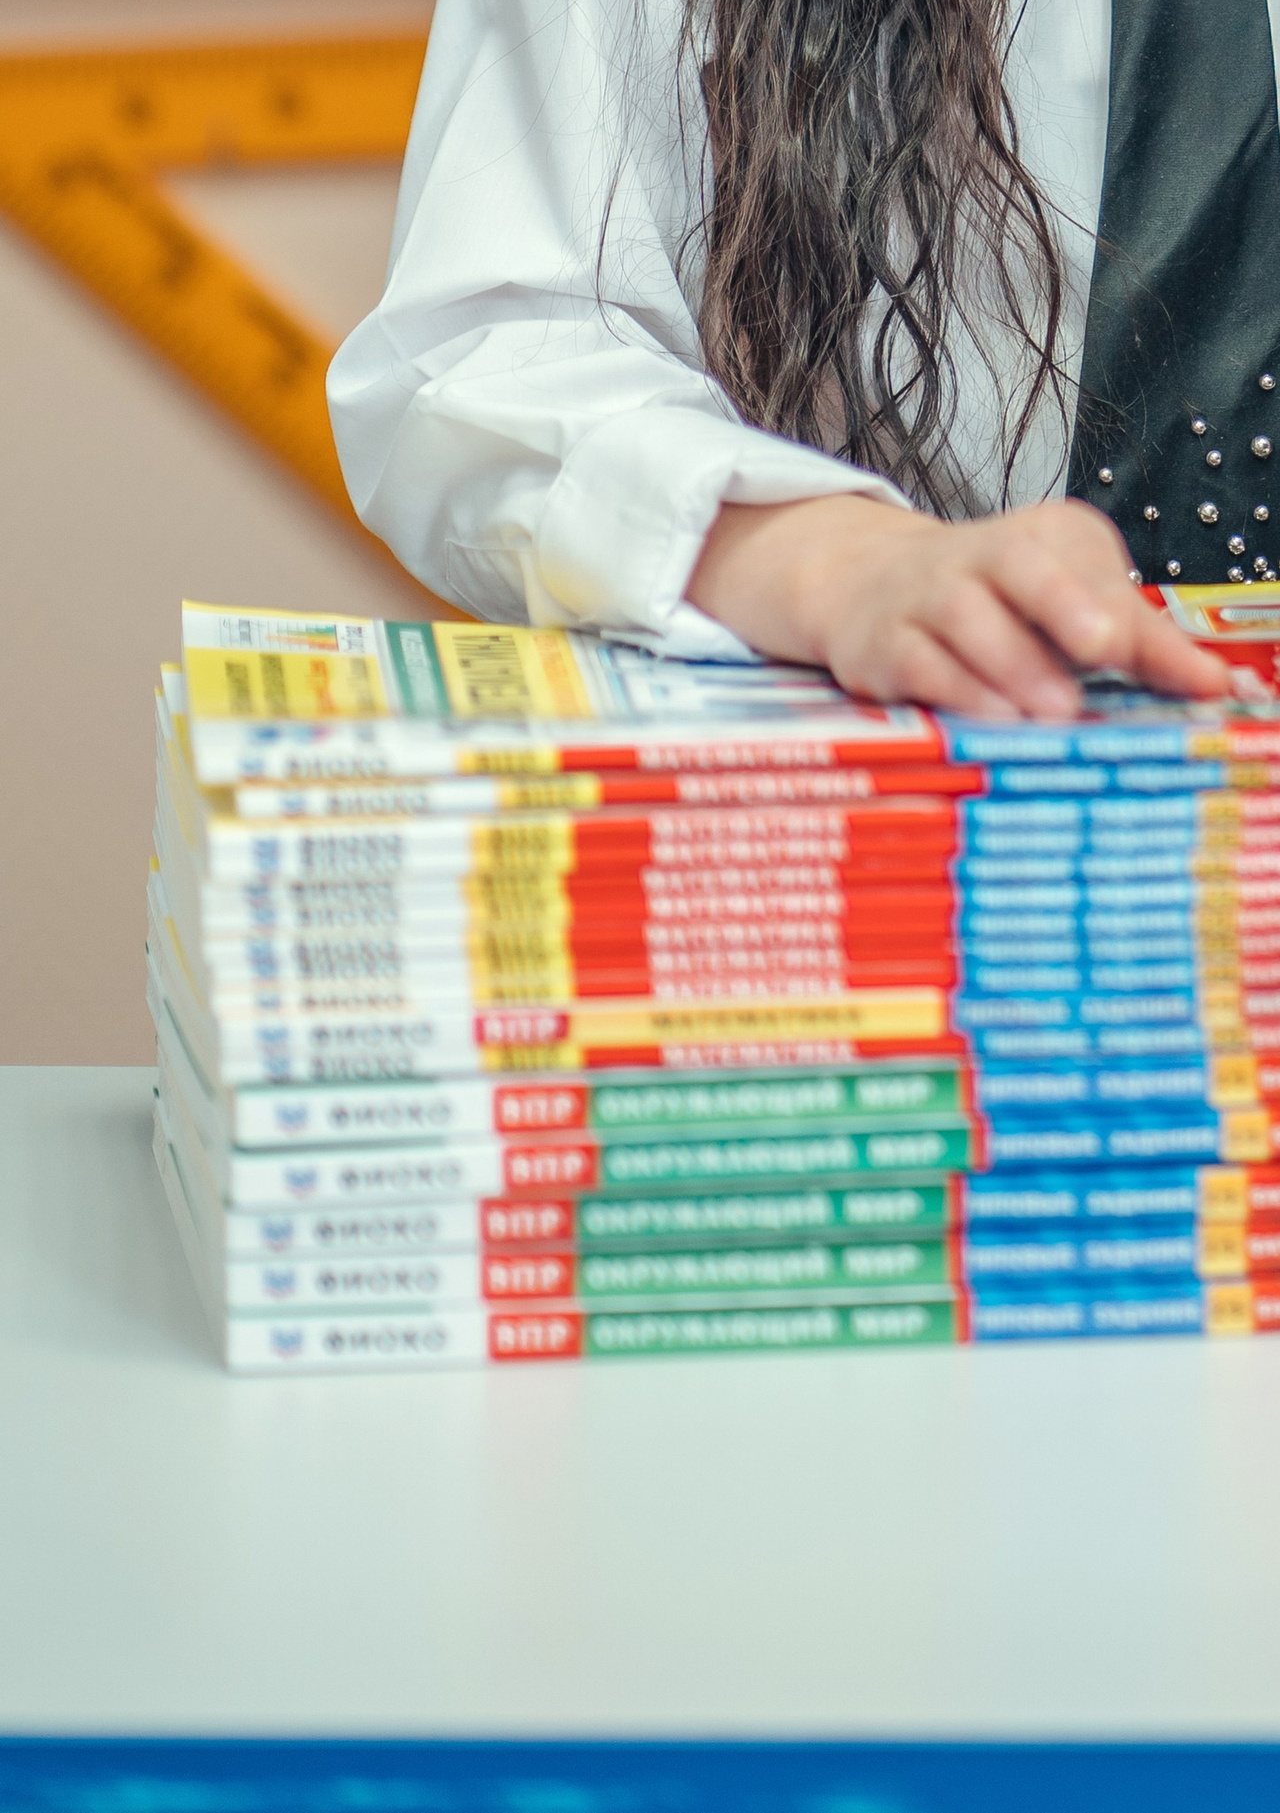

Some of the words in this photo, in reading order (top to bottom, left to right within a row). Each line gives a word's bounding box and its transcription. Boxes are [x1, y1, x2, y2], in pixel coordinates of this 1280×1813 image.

[502, 1092, 573, 1125] ВПР
[512, 1151, 583, 1185] ВПР
[489, 1203, 560, 1238] ВПР
[490, 1258, 560, 1293] ВПР
[498, 1318, 568, 1352] ВПР
